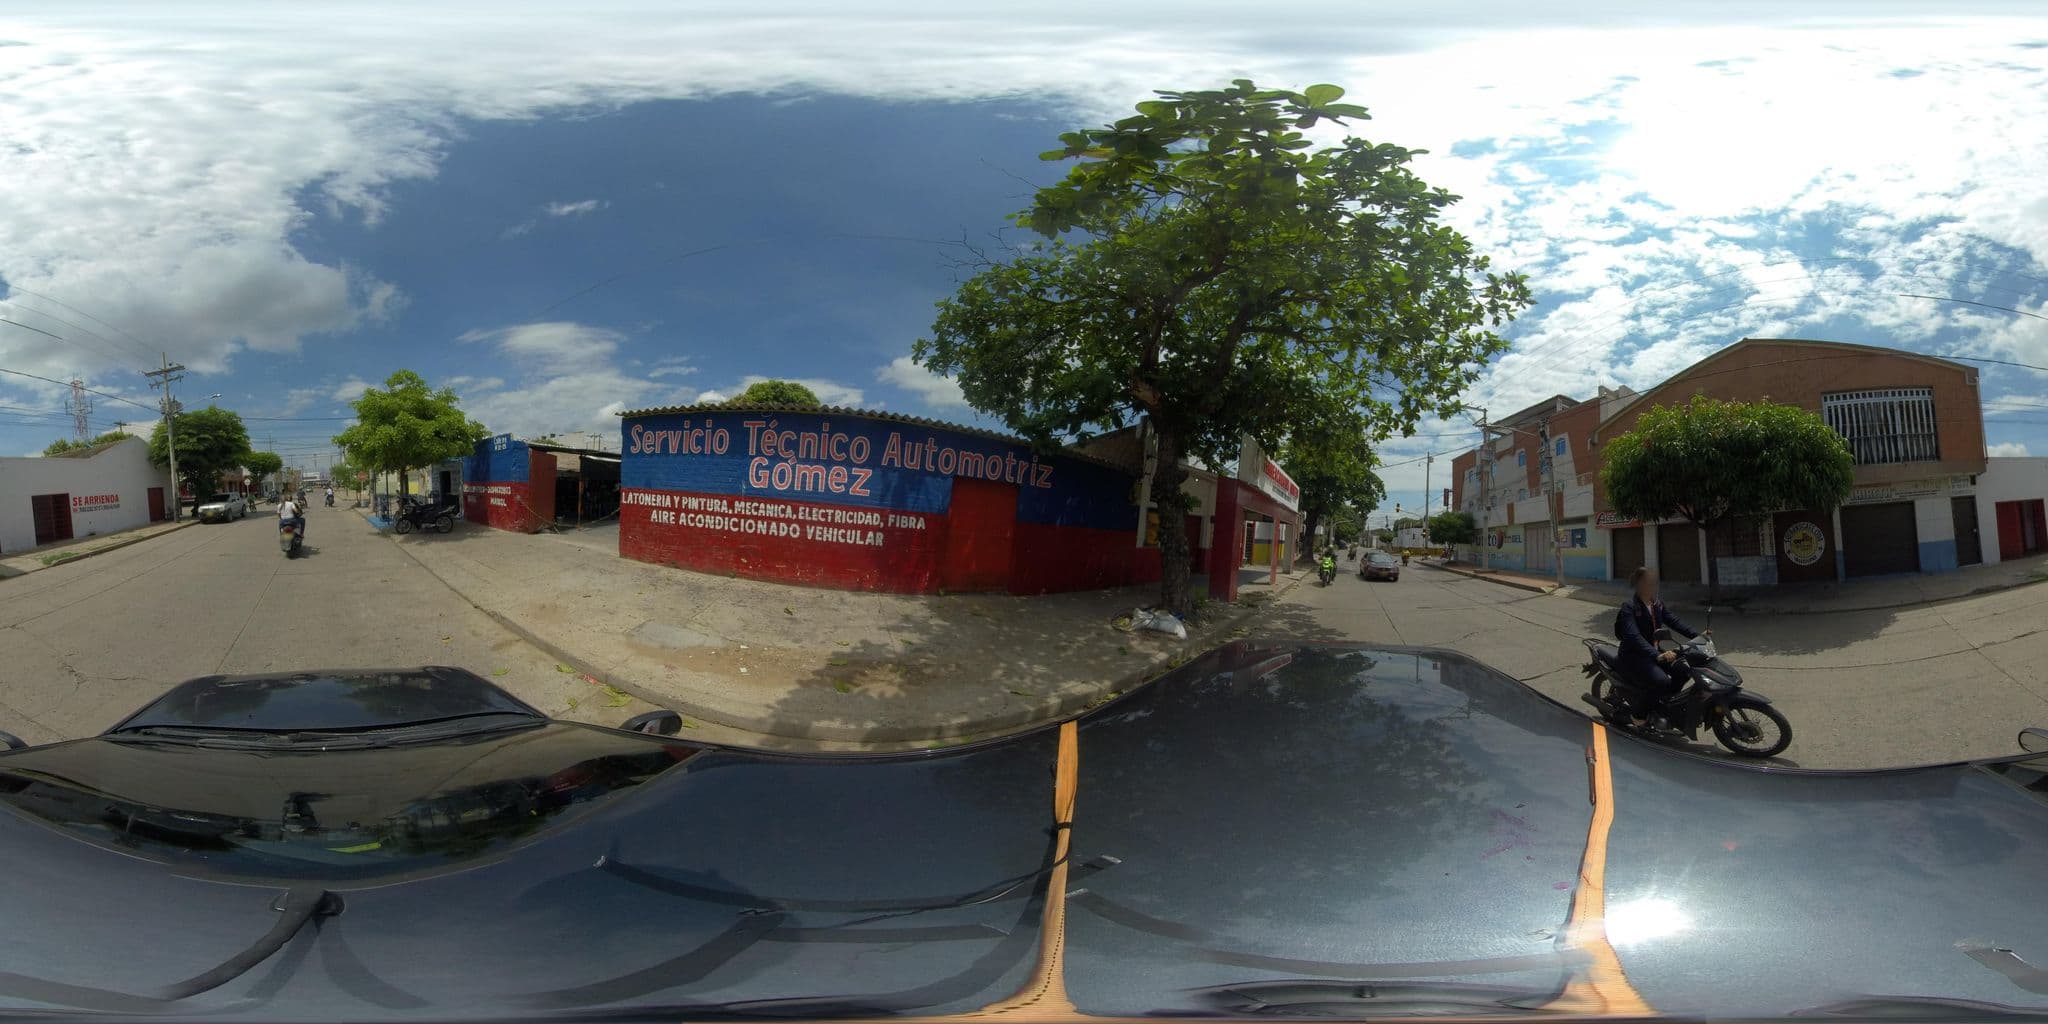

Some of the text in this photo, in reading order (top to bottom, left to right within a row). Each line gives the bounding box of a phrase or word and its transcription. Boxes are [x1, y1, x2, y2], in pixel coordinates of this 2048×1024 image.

[630, 419, 1054, 489] Servicio Técnico Automotriz
[749, 456, 873, 497] Gómez
[73, 494, 119, 506] SE ARRIENDA
[621, 492, 671, 508] LATONERIA
[673, 495, 680, 508] Y
[798, 506, 884, 529] ELECTRICIDAD,
[888, 514, 926, 530] FIBRA
[651, 510, 885, 547] AIRE ACONDICIONADO VEHICULAR
